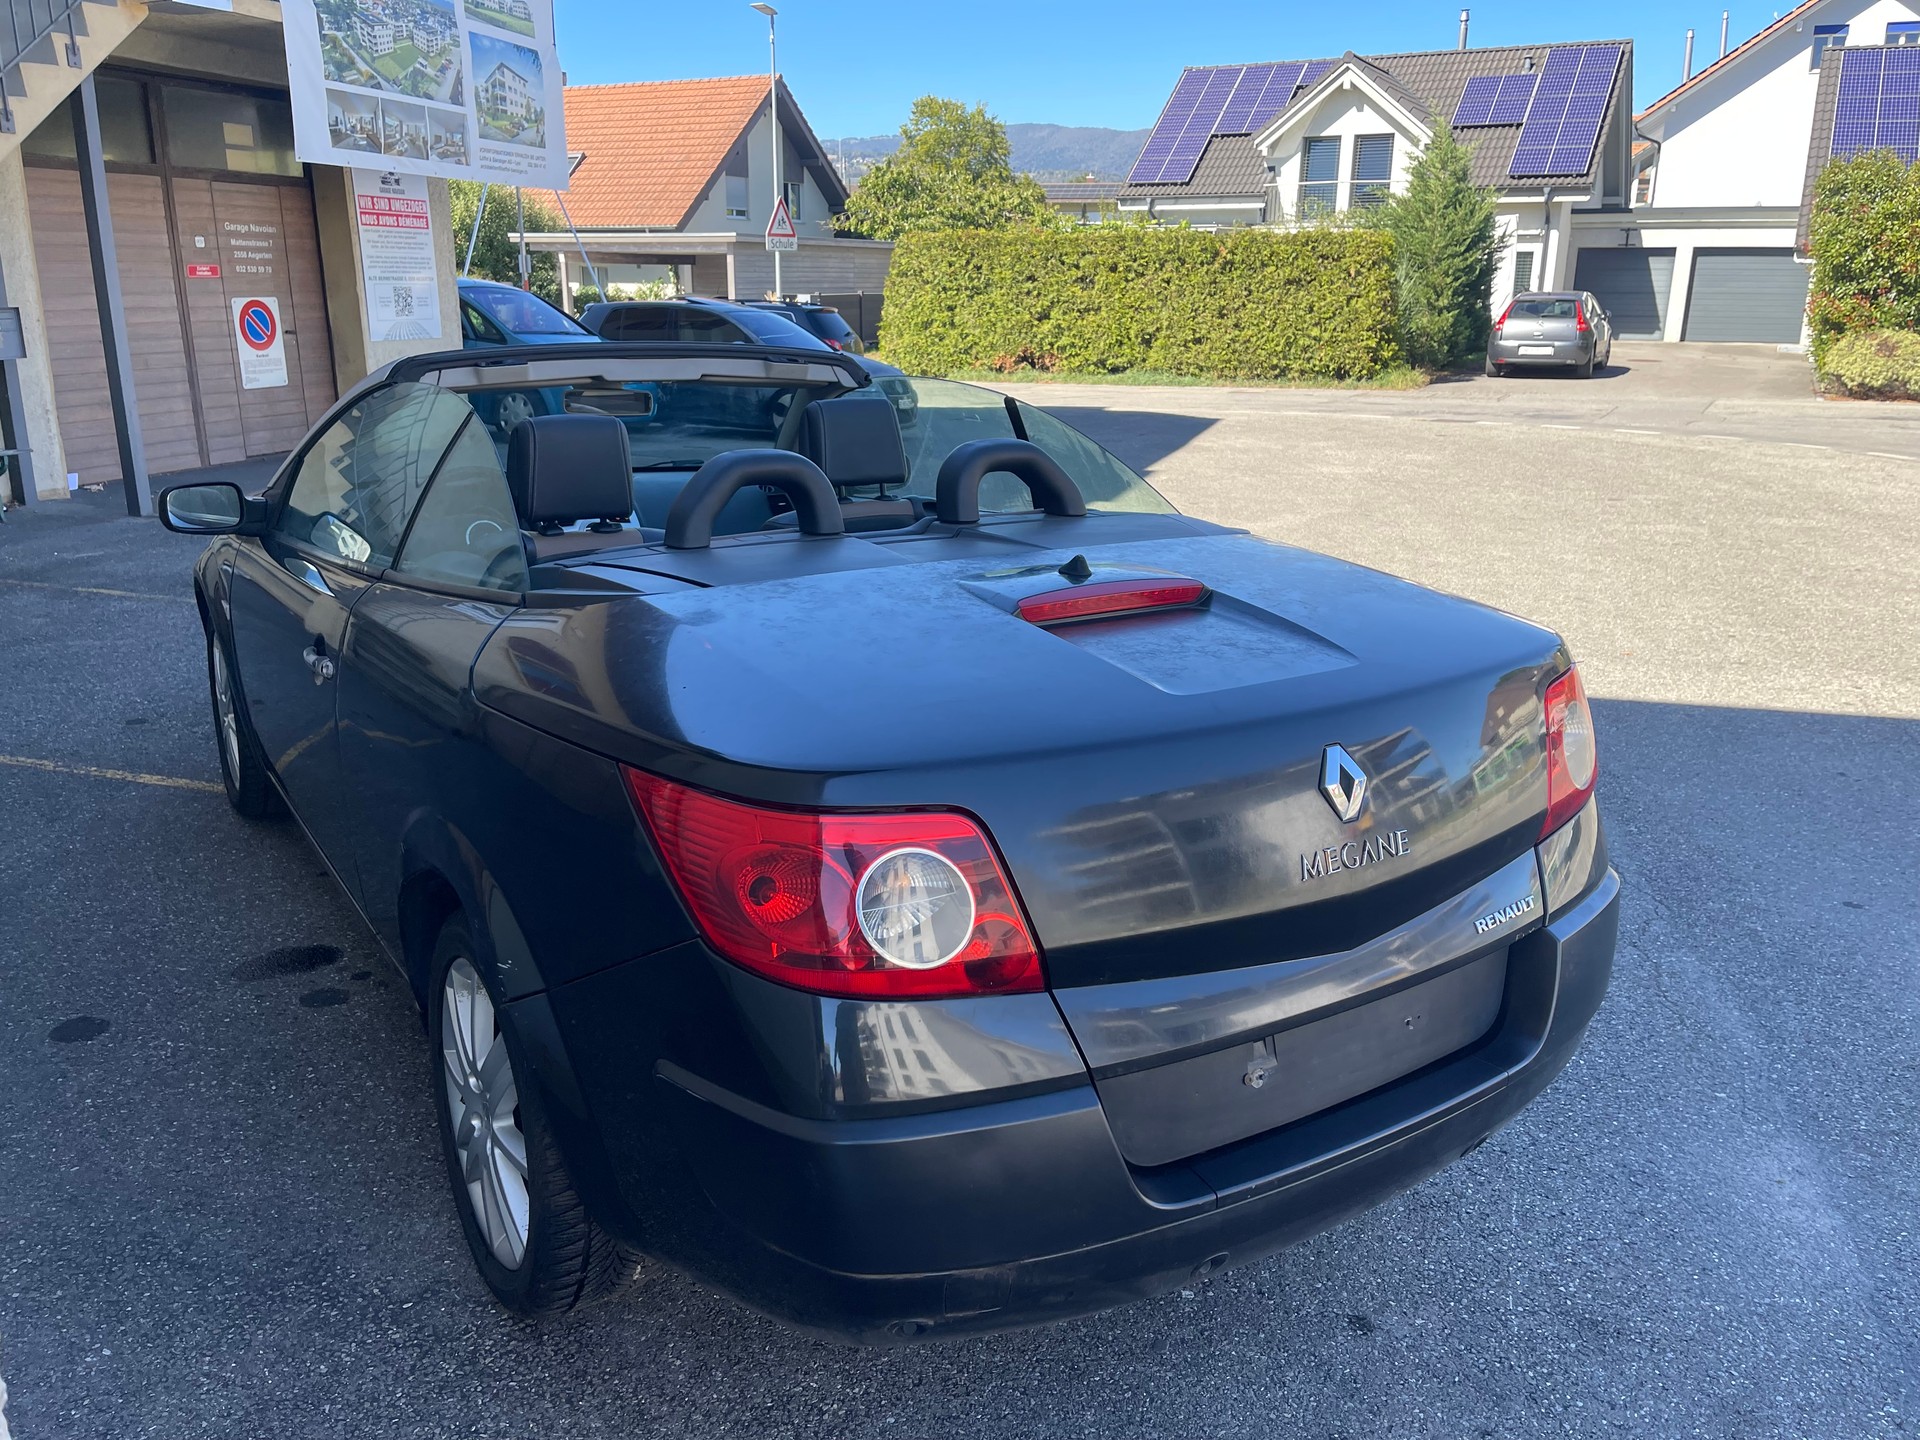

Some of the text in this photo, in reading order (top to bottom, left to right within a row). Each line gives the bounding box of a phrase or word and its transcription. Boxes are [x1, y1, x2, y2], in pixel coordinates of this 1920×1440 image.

[358, 195, 427, 213] WIR SIND UMGEZOGEN
[224, 221, 277, 233] Garage Navoian
[361, 214, 428, 228] NOUS AVONS DÉMÉNAGÉ
[230, 238, 273, 247] Mattenstrasse 7
[770, 238, 794, 249] Schule
[233, 250, 273, 260] 2558 Aegerten
[1300, 829, 1411, 882] MEGANE
[1473, 895, 1535, 935] RENAULT
